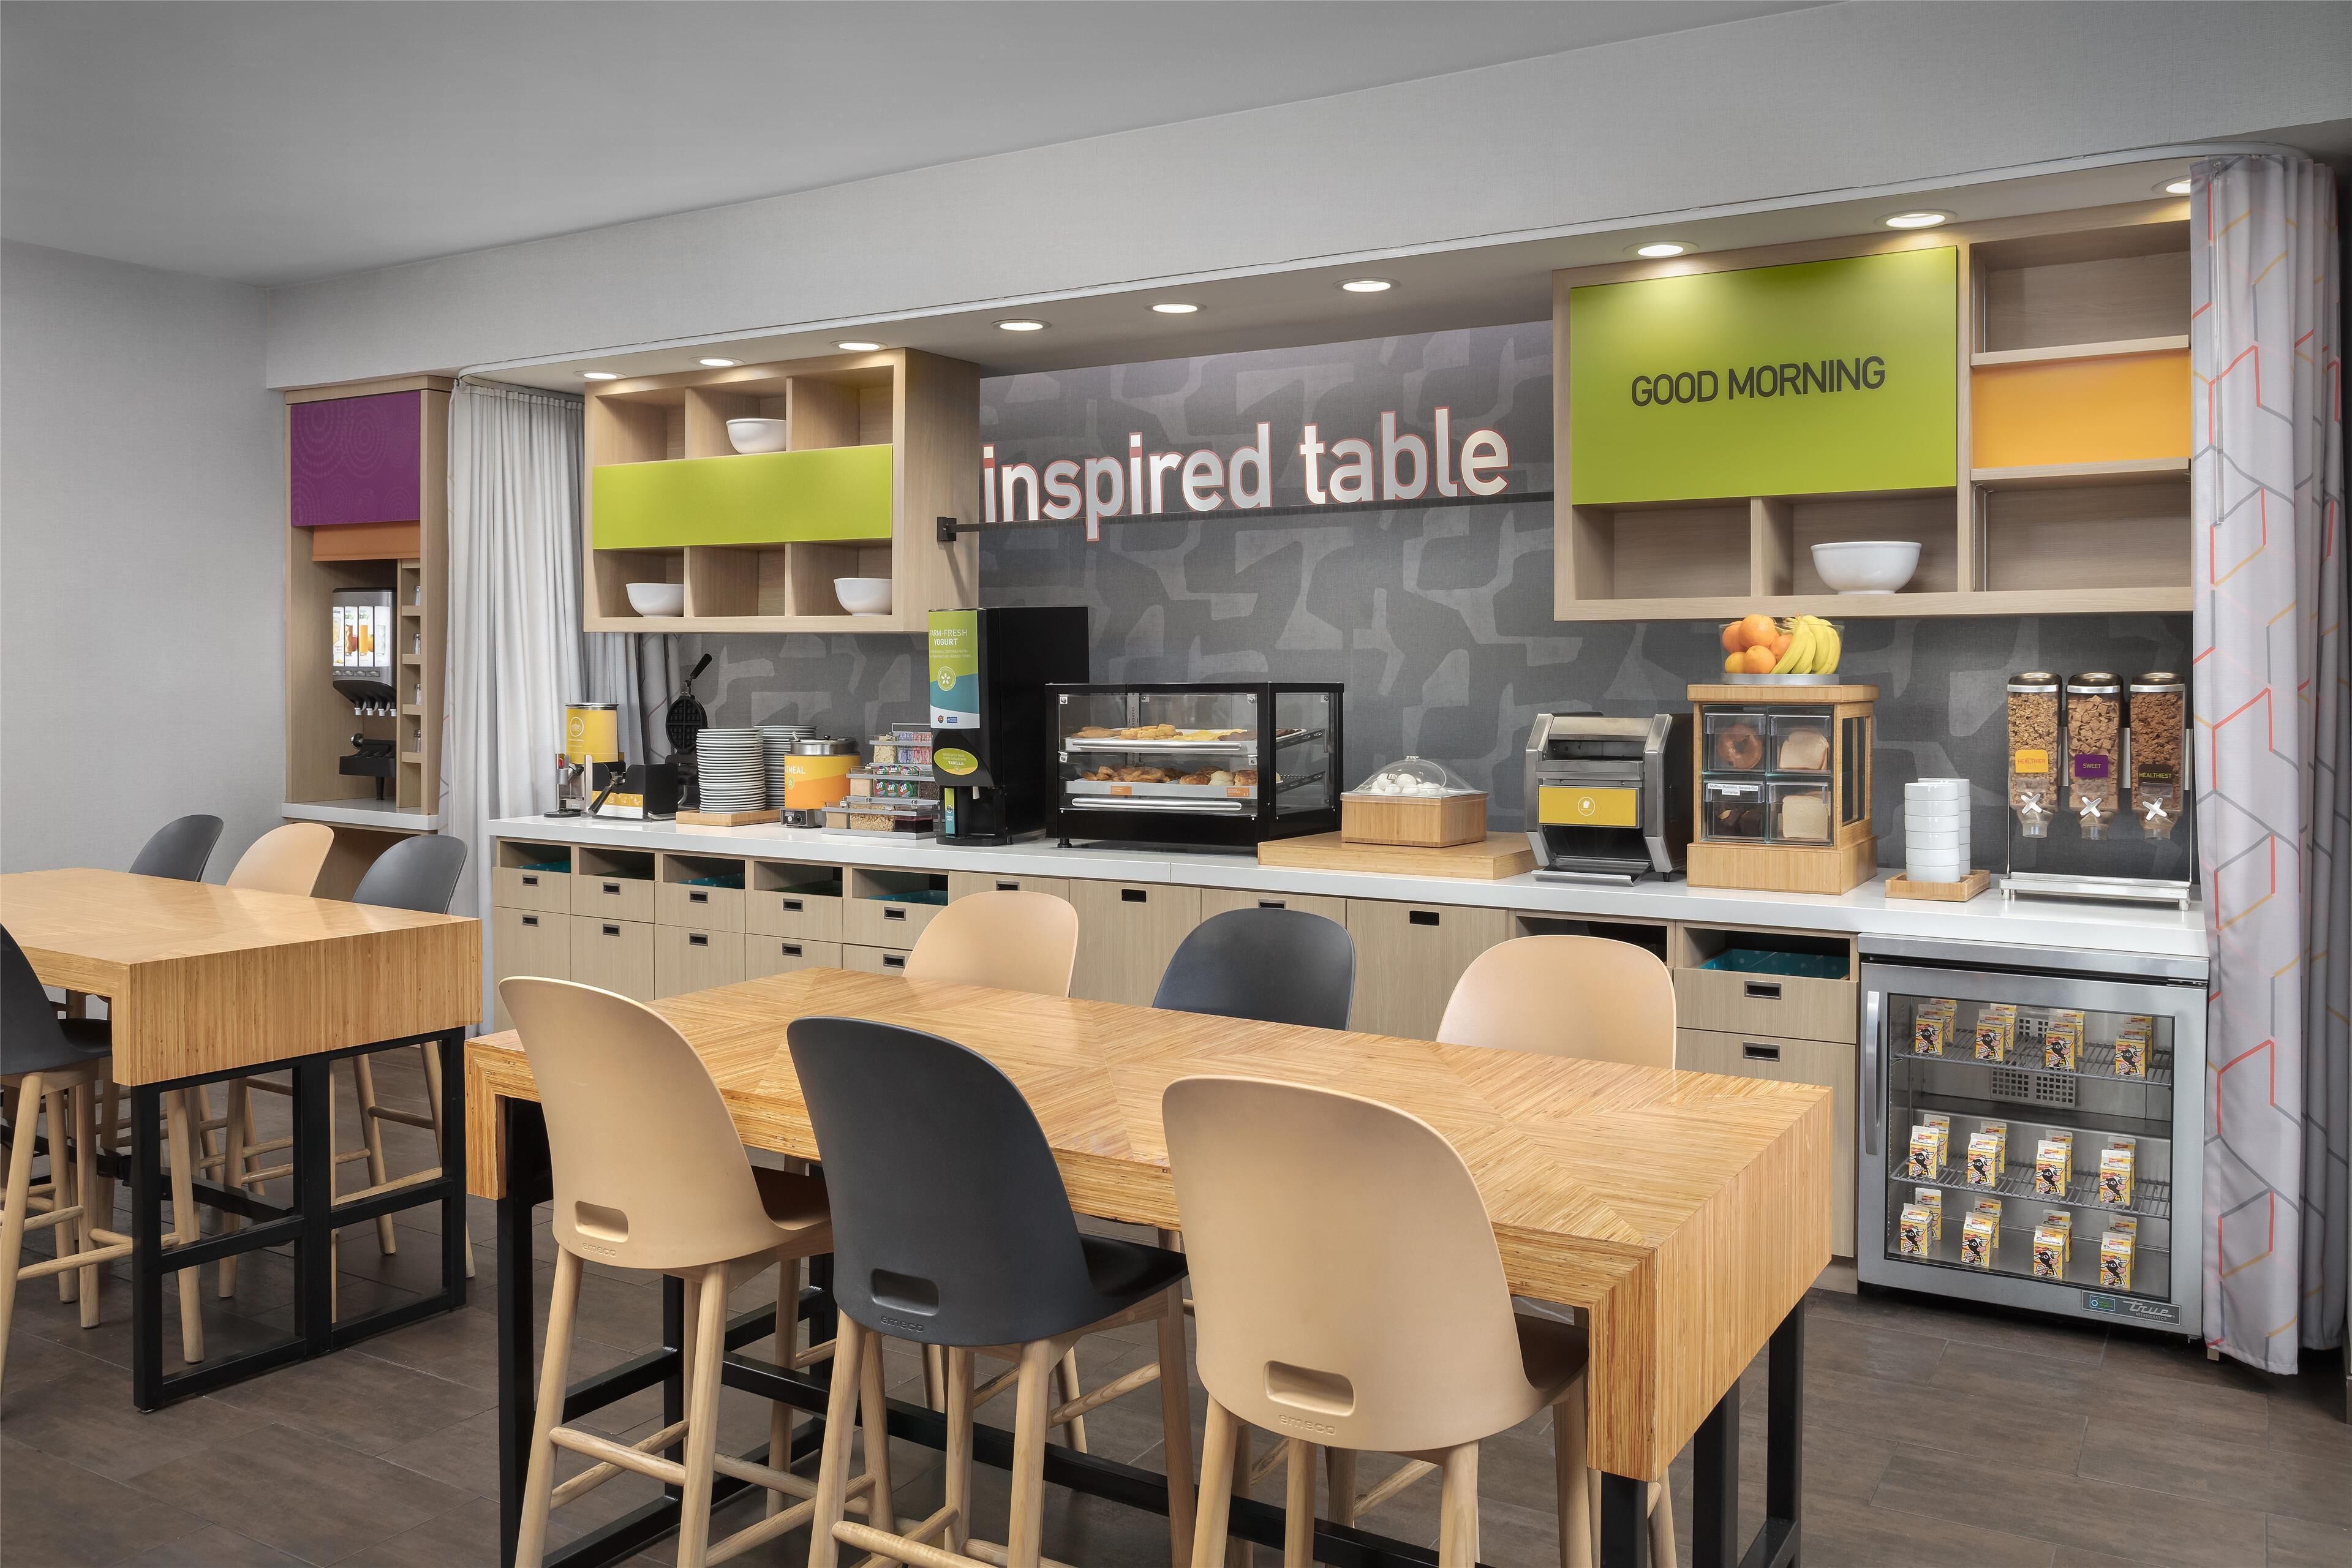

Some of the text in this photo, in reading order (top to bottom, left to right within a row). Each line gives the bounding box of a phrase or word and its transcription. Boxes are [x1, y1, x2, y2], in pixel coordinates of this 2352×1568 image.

[1632, 356, 1886, 407] GOOD MORNING
[982, 406, 1511, 541] inspired table
[582, 1242, 617, 1257] emeco
[881, 1316, 924, 1333] emeco
[2135, 1313, 2167, 1322] REFRIGERATOR
[1278, 1414, 1336, 1436] emeco
